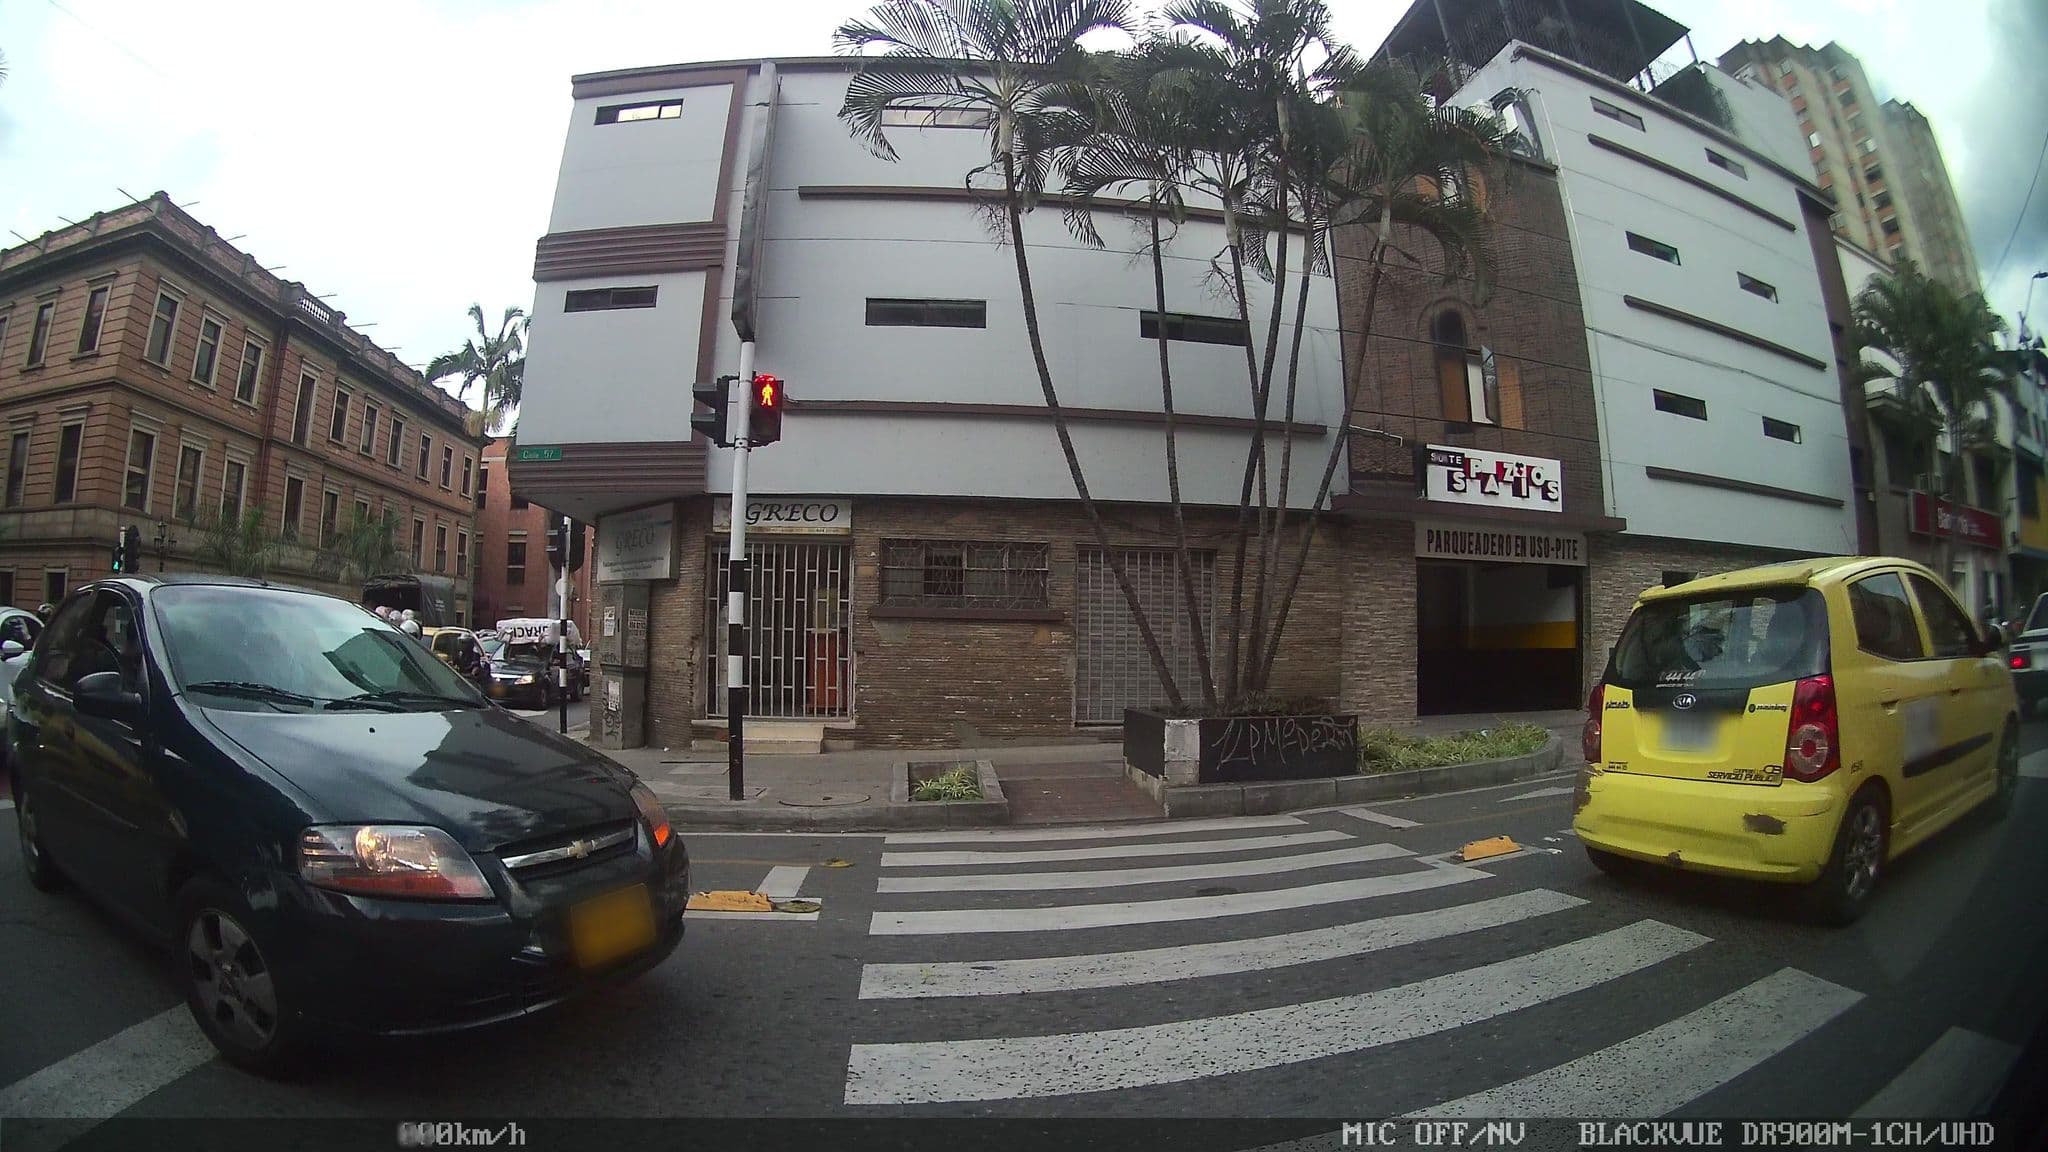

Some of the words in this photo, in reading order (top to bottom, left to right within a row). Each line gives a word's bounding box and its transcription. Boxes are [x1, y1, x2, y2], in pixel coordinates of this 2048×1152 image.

[1430, 452, 1462, 465] SUTE
[745, 502, 839, 525] GRECO
[1427, 529, 1512, 557] PARQUEADERO
[1514, 535, 1527, 558] EN
